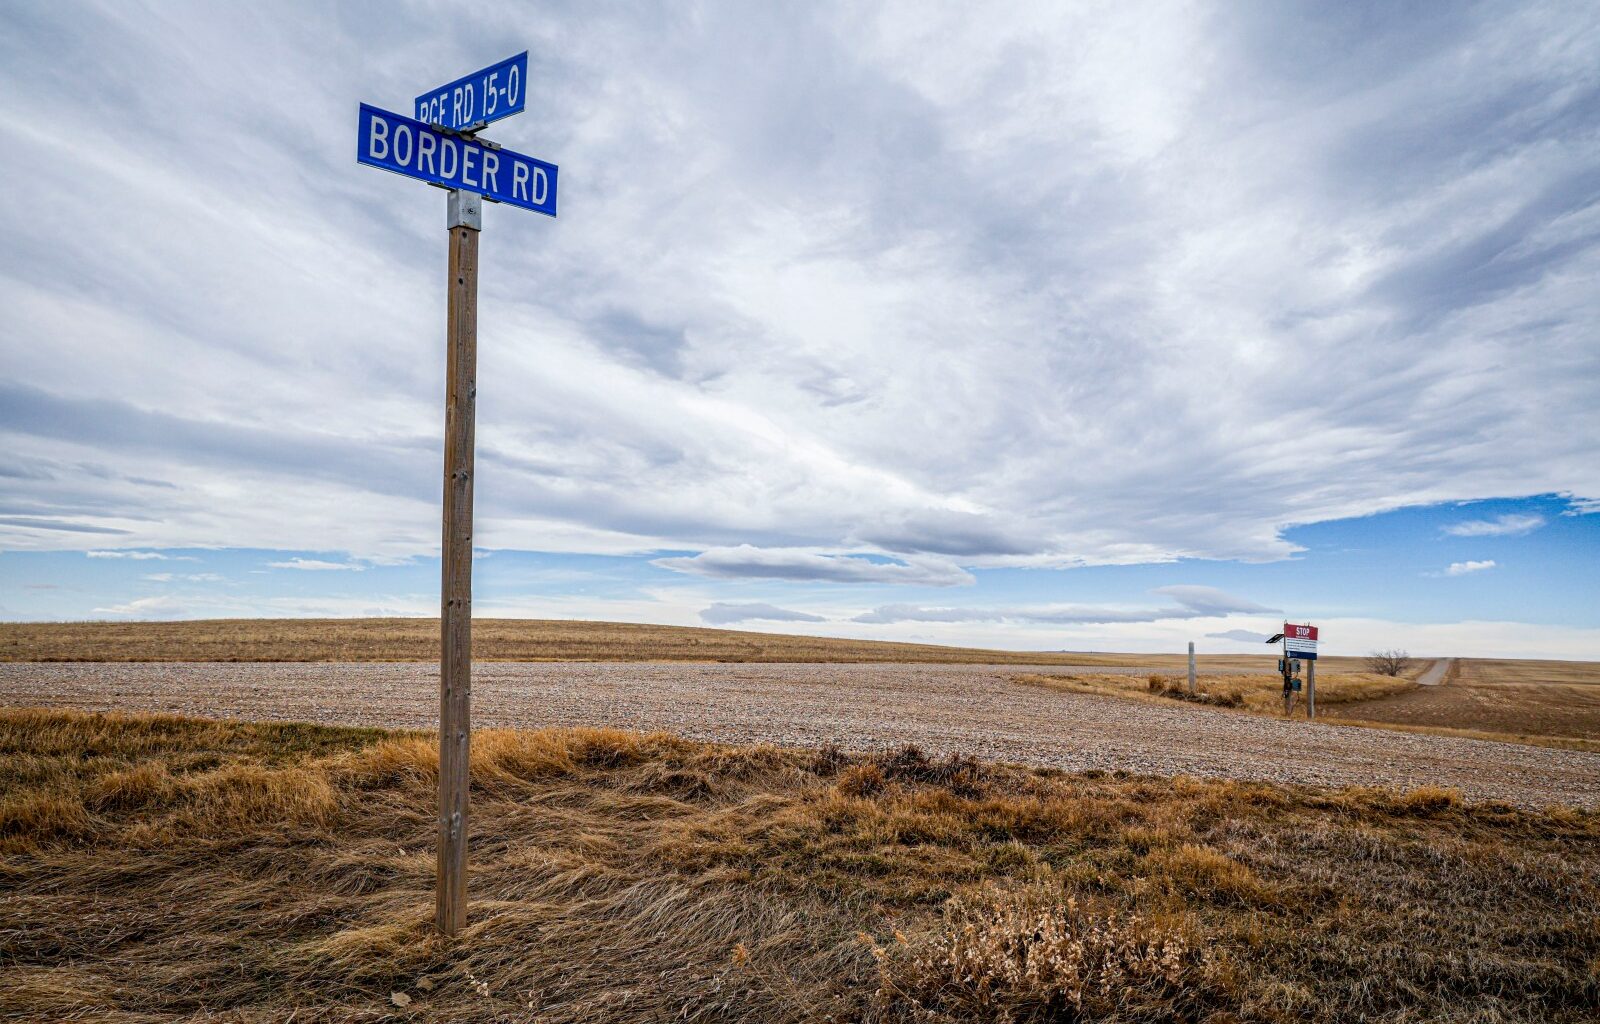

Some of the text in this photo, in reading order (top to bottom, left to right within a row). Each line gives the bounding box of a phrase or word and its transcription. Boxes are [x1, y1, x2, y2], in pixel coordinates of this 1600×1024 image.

[453, 83, 474, 127] RD
[482, 64, 519, 117] 15-0
[369, 115, 548, 206] BORDER RD
[1296, 626, 1310, 636] STOP
